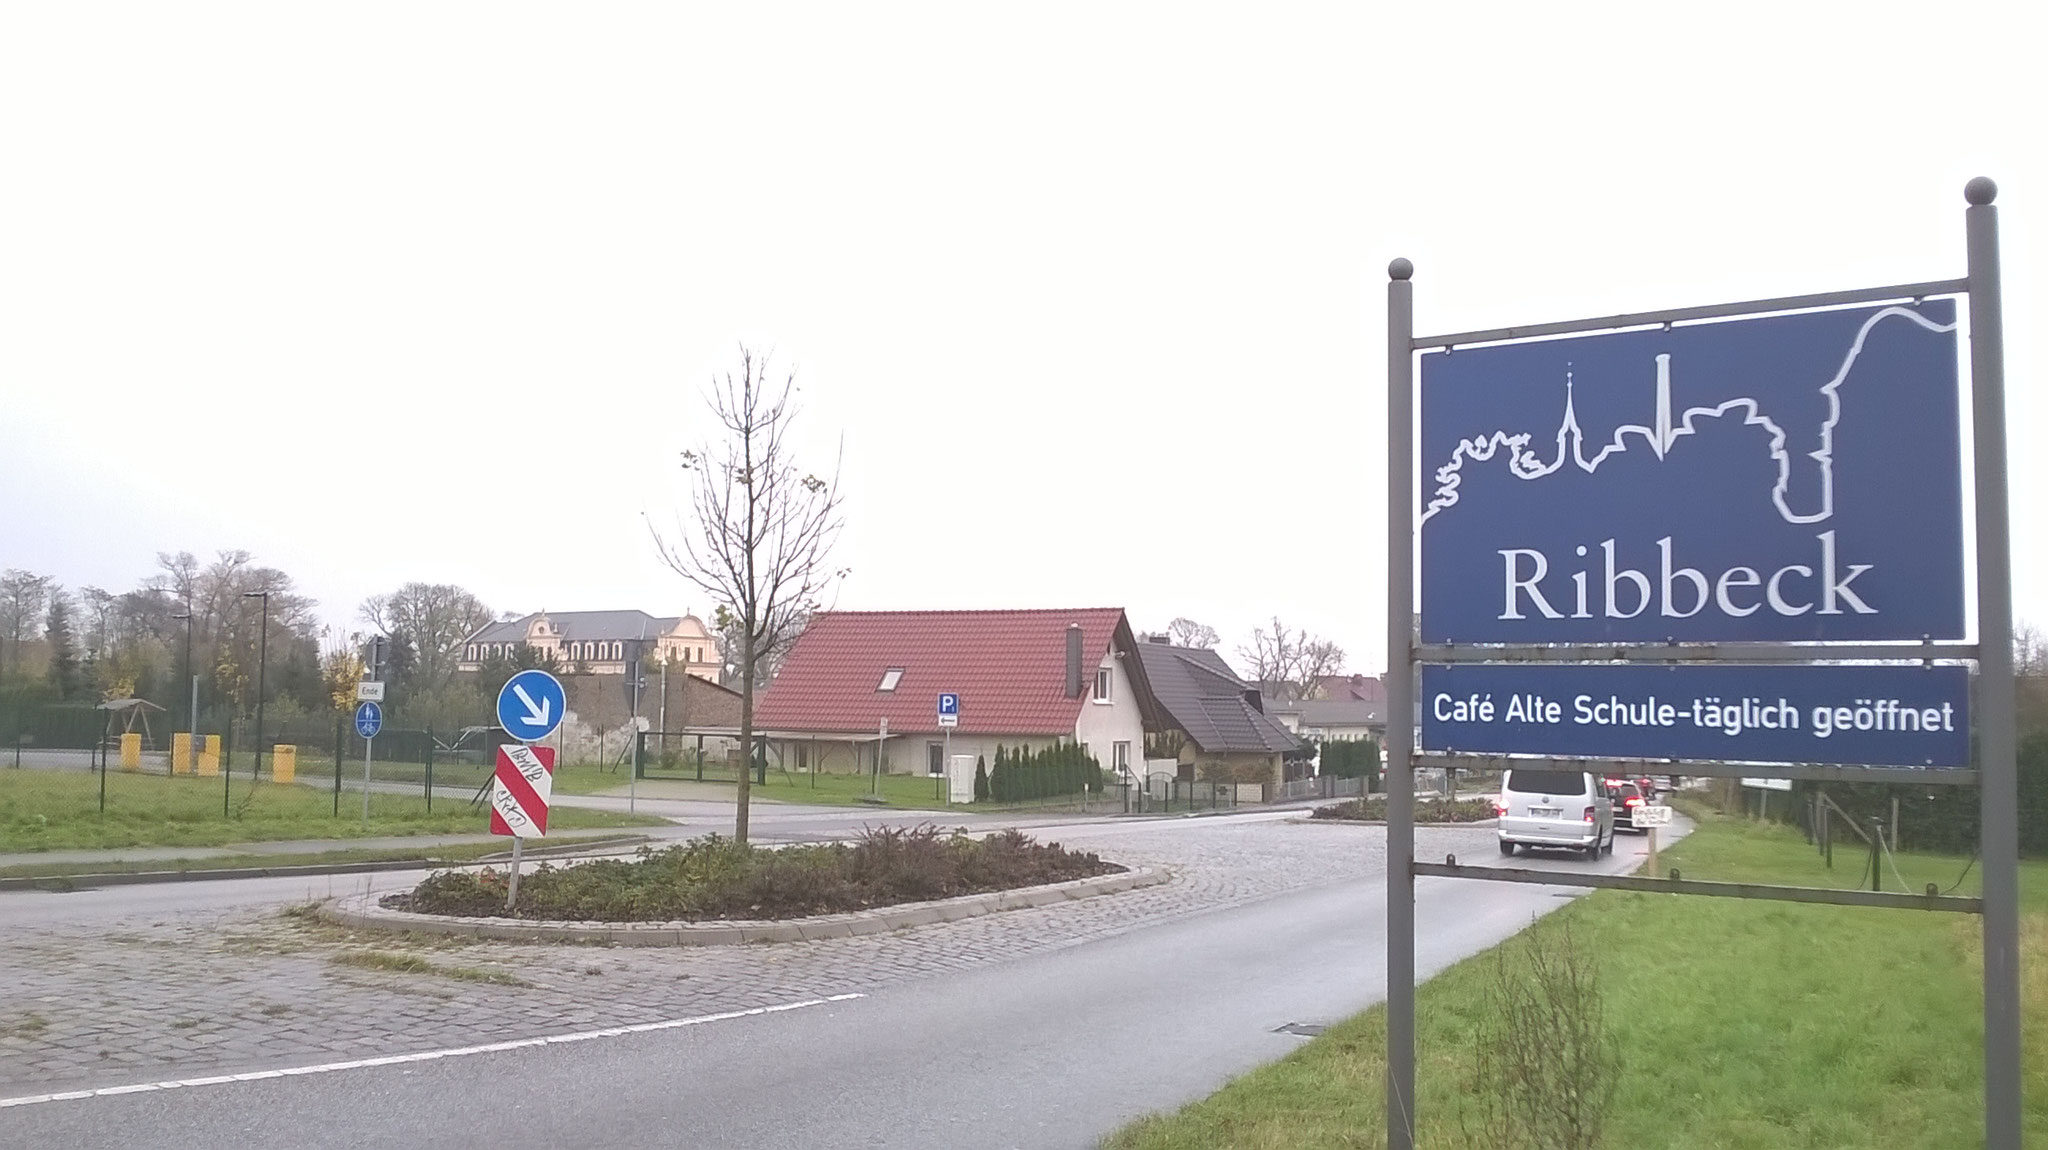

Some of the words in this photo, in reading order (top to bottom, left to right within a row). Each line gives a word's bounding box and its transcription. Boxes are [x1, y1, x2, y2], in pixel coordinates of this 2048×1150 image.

[1498, 530, 1879, 619] Ribbeck
[361, 686, 379, 696] Ende
[942, 695, 954, 712] P
[1434, 693, 1495, 722] Café
[1505, 694, 1562, 723] Alte
[1812, 699, 1954, 738] geöffnet
